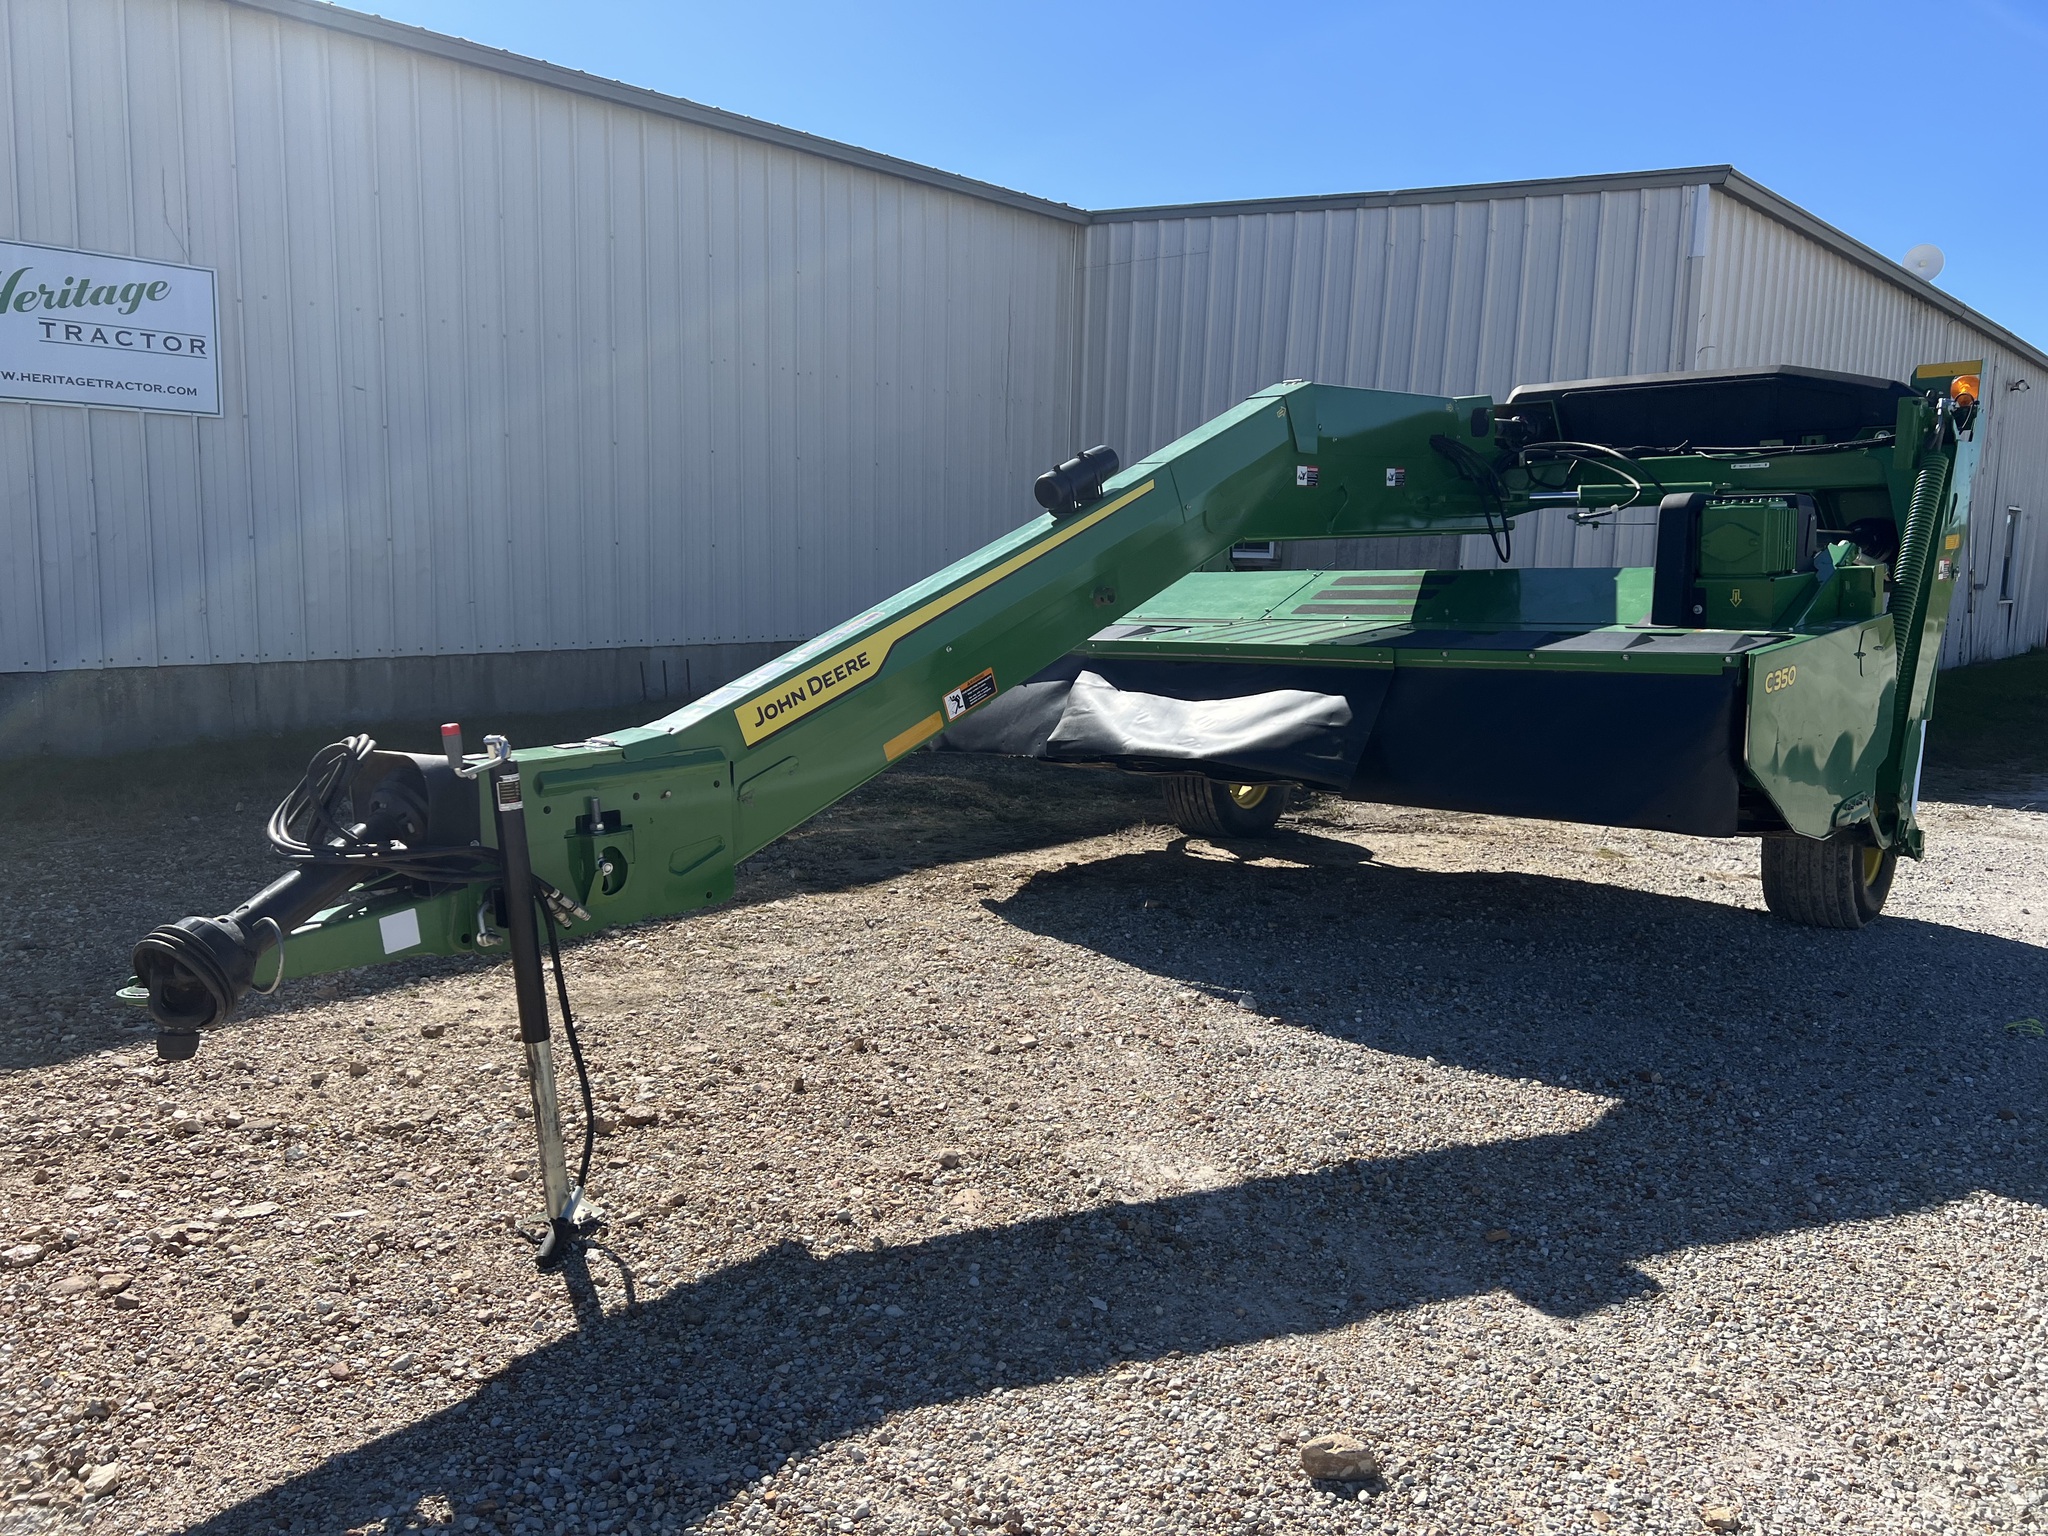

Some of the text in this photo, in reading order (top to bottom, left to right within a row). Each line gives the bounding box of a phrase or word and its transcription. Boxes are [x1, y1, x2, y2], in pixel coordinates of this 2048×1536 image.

[39, 321, 206, 355] TRACTOR
[754, 651, 871, 728] JOHN DEERE
[1764, 664, 1797, 695] C350
